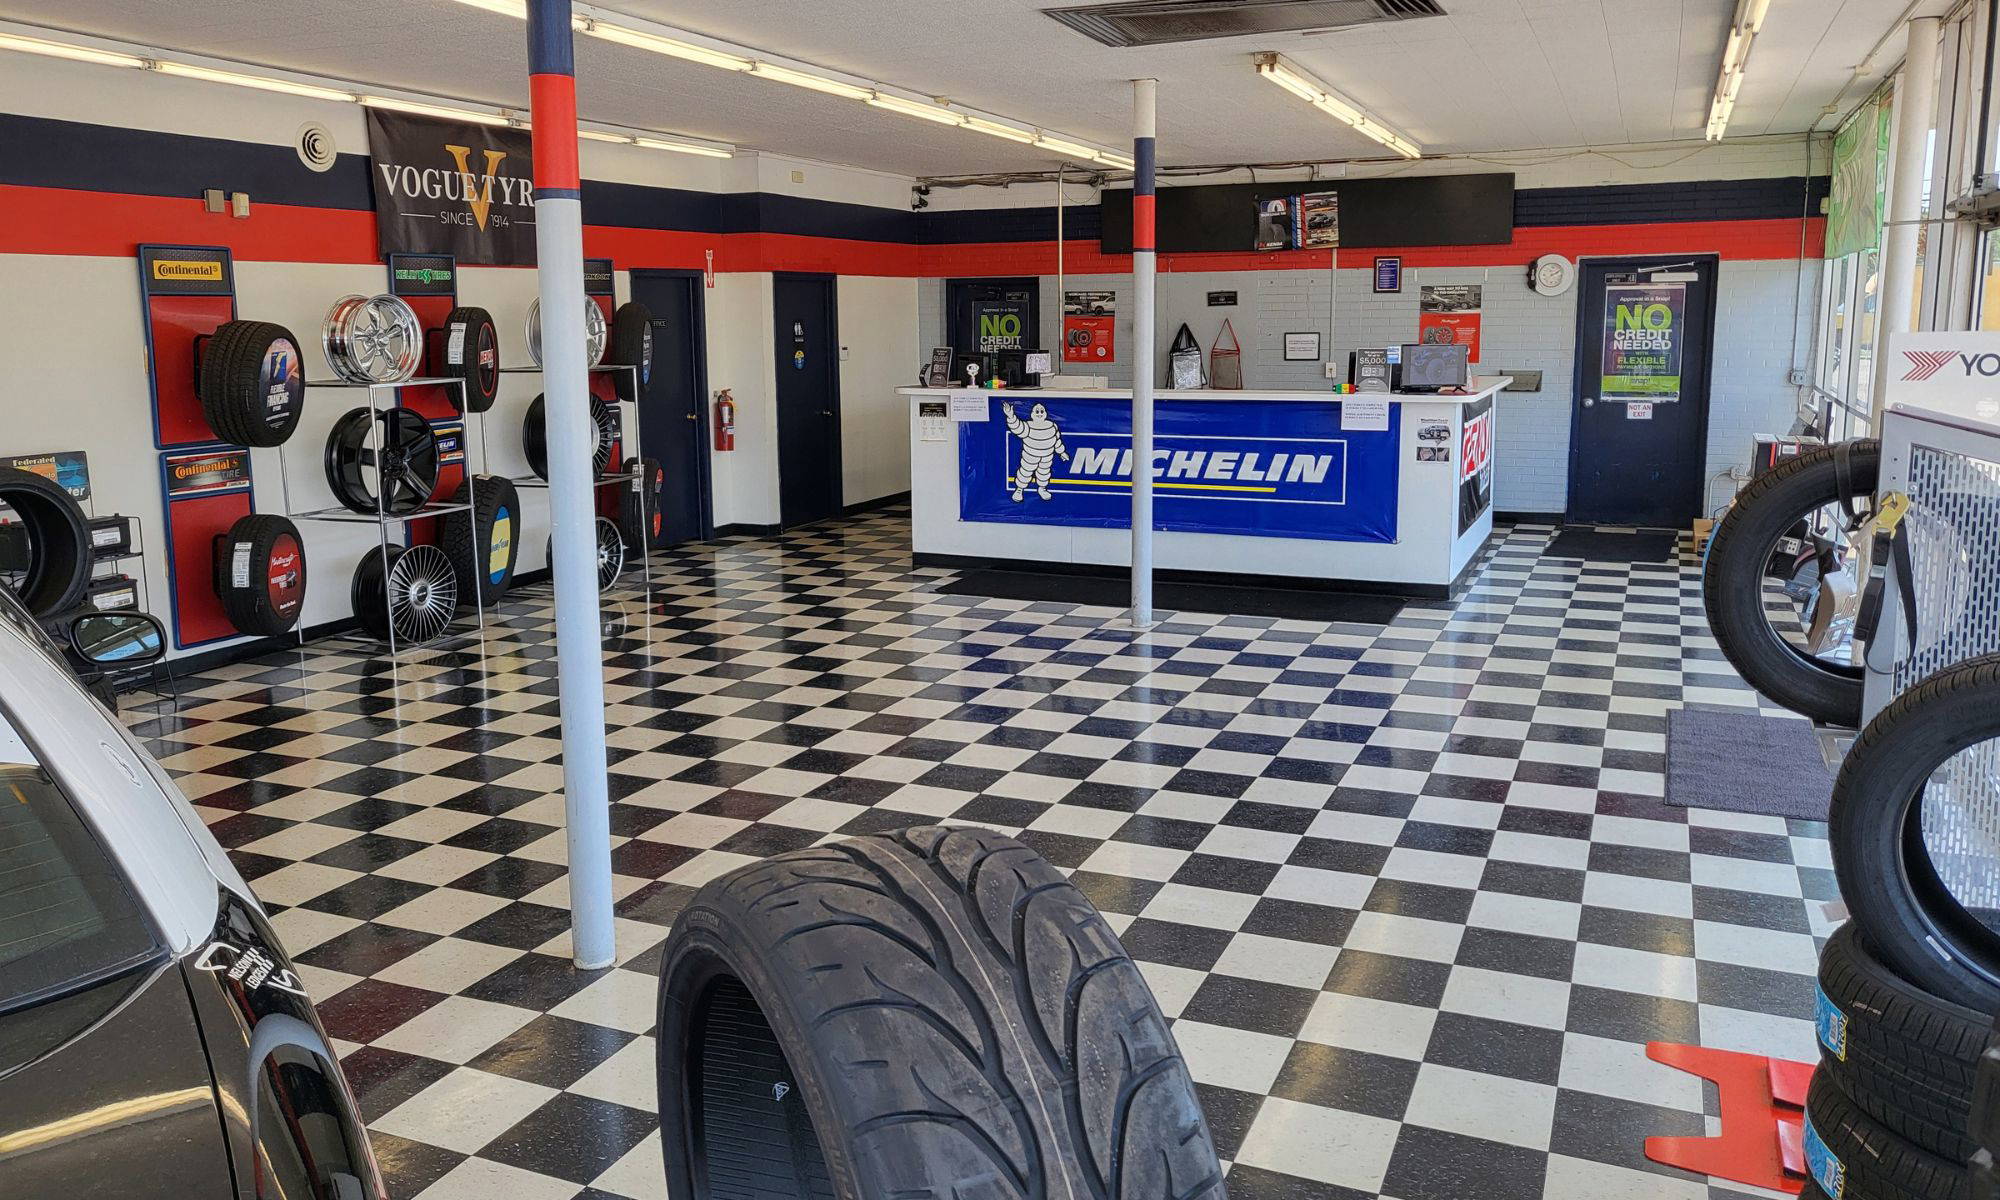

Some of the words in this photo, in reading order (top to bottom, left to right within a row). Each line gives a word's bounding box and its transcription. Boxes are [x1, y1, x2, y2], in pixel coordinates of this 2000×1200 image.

[378, 163, 477, 202] VOGUE
[481, 174, 536, 207] TYR
[440, 211, 473, 226] SINCE
[490, 214, 510, 228] 1914
[158, 263, 213, 277] Continental
[395, 269, 417, 280] KELLY
[431, 270, 452, 280] TIRES
[1616, 303, 1672, 331] NO
[980, 314, 1021, 336] NO
[980, 335, 1021, 345] CREDIT
[1614, 329, 1672, 340] CREDIT
[1613, 340, 1672, 350] NEEDED
[1360, 357, 1387, 365] $5,000
[1617, 357, 1666, 365] FLEXIBLE
[12, 456, 56, 467] Federated
[175, 459, 230, 479] Continental
[221, 468, 241, 480] TIRE
[66, 486, 86, 497] ter
